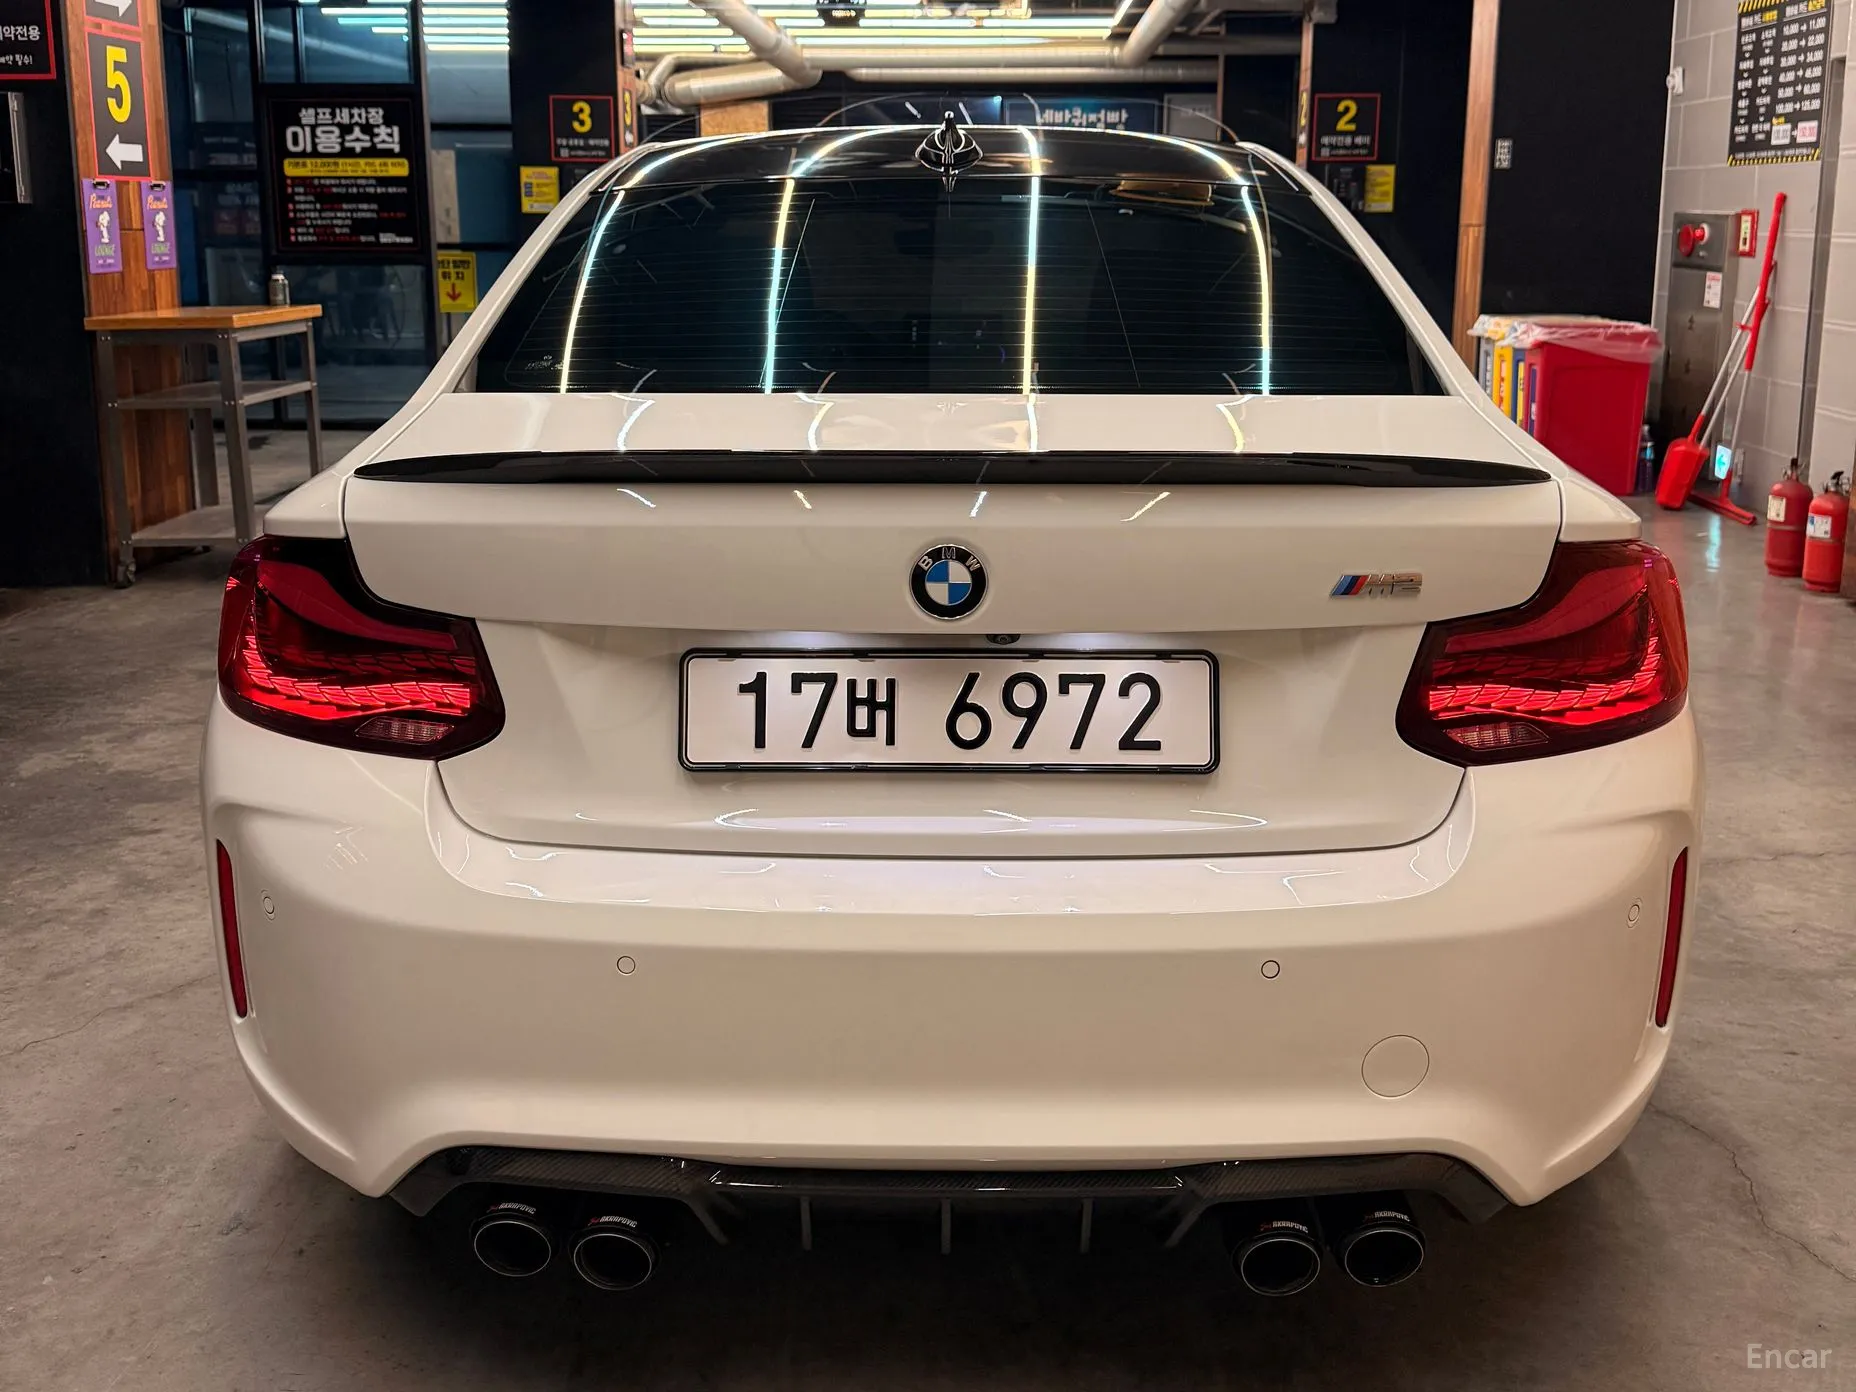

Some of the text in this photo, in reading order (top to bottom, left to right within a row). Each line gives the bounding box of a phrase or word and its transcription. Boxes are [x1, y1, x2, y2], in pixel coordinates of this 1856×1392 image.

[0, 25, 41, 41] 약전용
[106, 45, 131, 123] 5
[298, 107, 385, 125] 셀프세차장
[572, 101, 592, 133] 3
[1336, 99, 1357, 131] 2
[286, 125, 400, 153] 이용수칙
[918, 547, 981, 571] BMW
[738, 671, 1163, 751] 17버 6972
